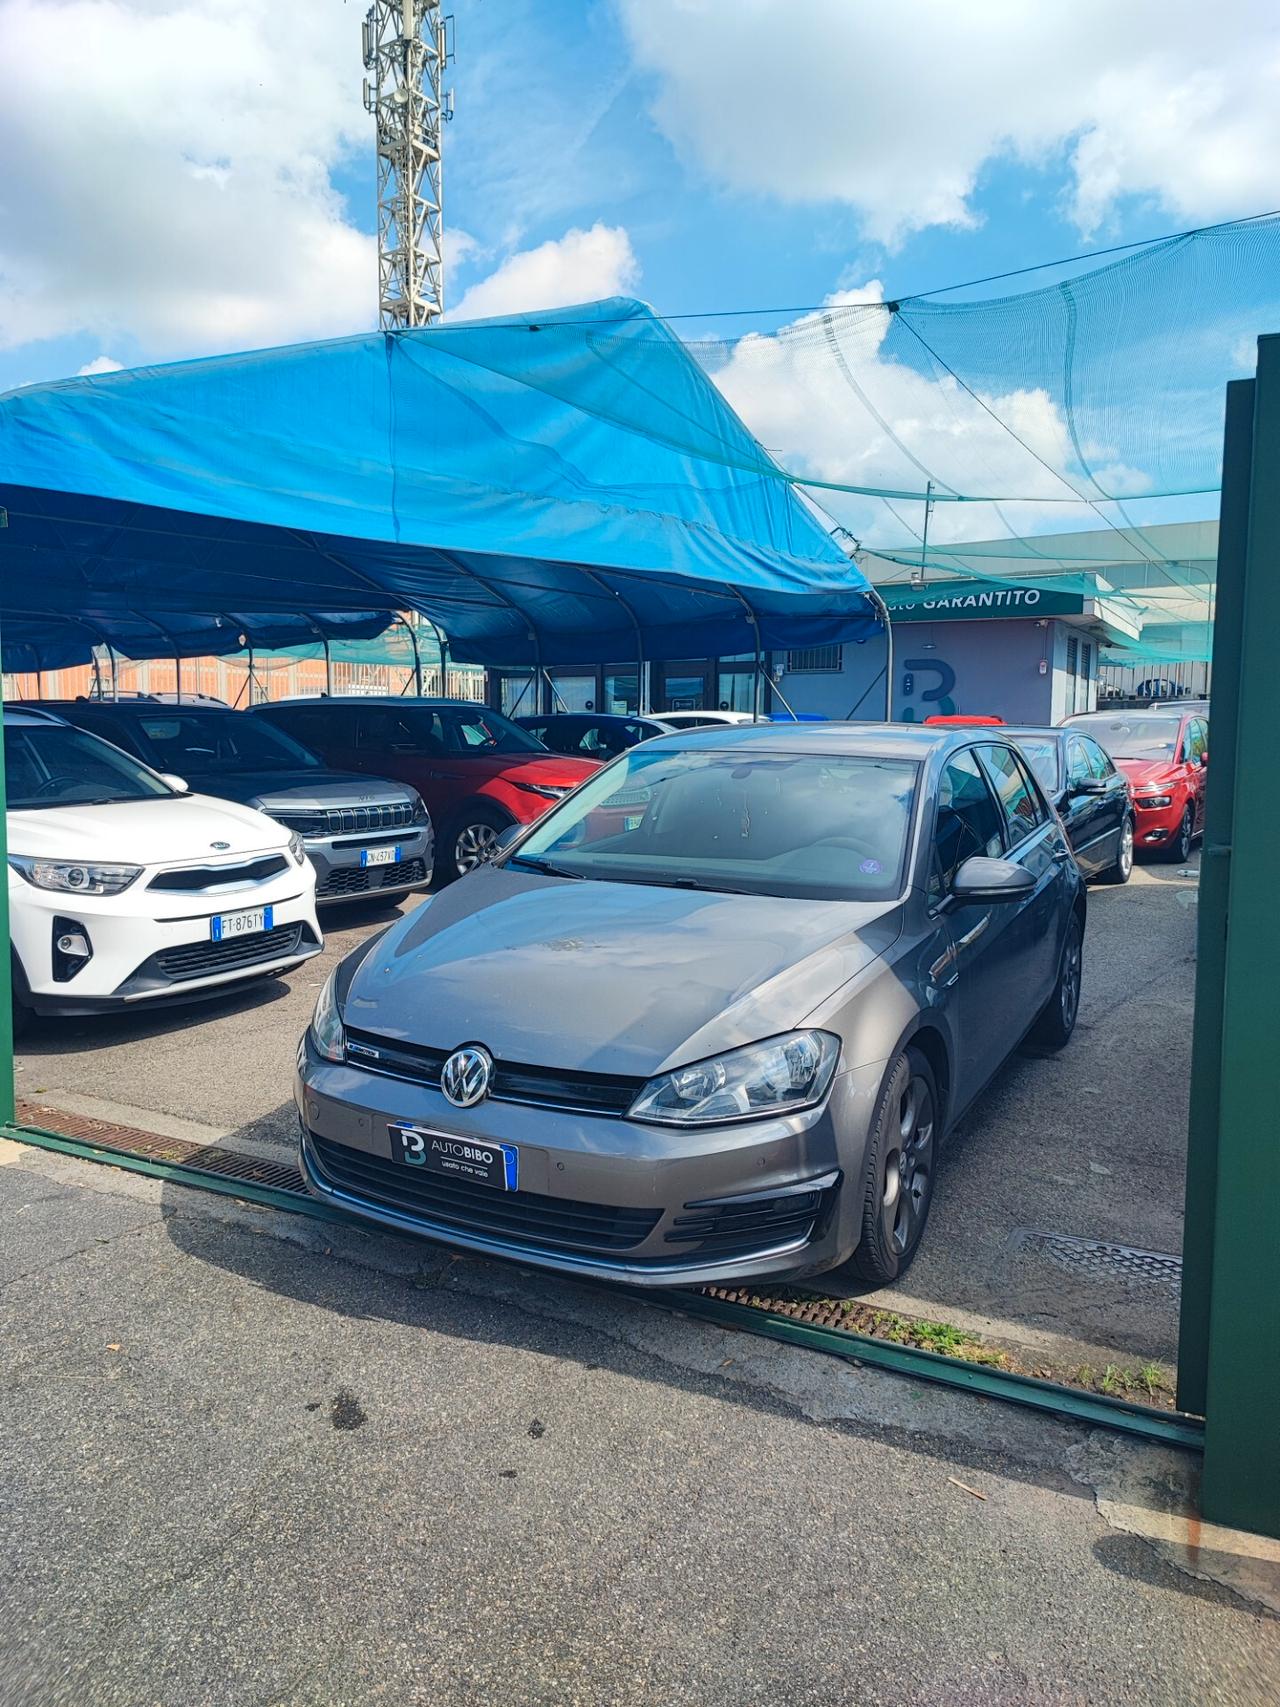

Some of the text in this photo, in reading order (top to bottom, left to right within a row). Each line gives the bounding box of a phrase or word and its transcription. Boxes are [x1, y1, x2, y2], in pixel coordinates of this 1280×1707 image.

[923, 589, 1041, 609] GARANTITO
[431, 1140, 494, 1164] AUTOBIBO
[441, 1160, 489, 1178] usato che vale
